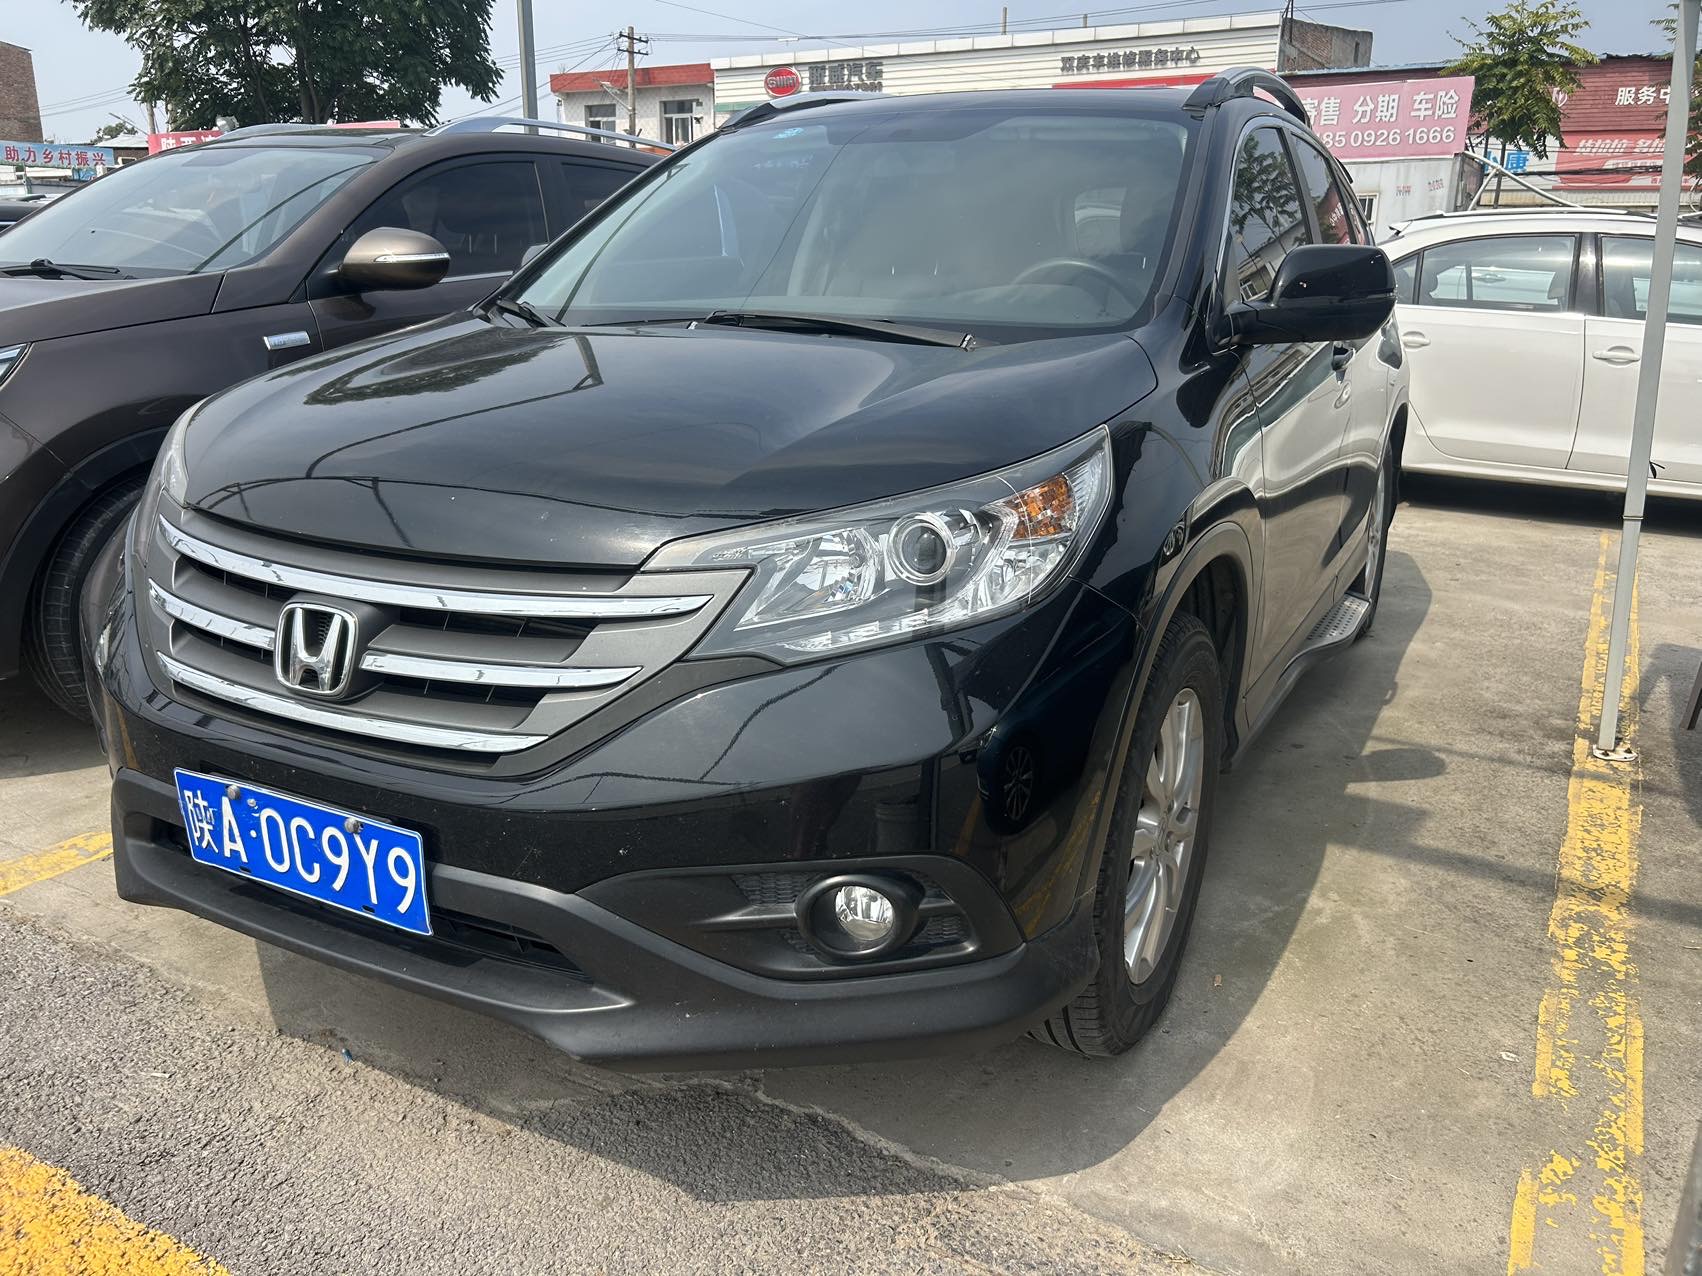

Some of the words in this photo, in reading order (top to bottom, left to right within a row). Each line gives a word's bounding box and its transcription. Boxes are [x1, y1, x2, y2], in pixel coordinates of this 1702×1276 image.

[1352, 93, 1399, 124] 分期
[1410, 89, 1460, 121] 车险
[1316, 131, 1346, 148] 85
[1350, 129, 1401, 147] 0926
[1404, 126, 1455, 144] 1666
[4, 145, 106, 166] 助力乡村振兴
